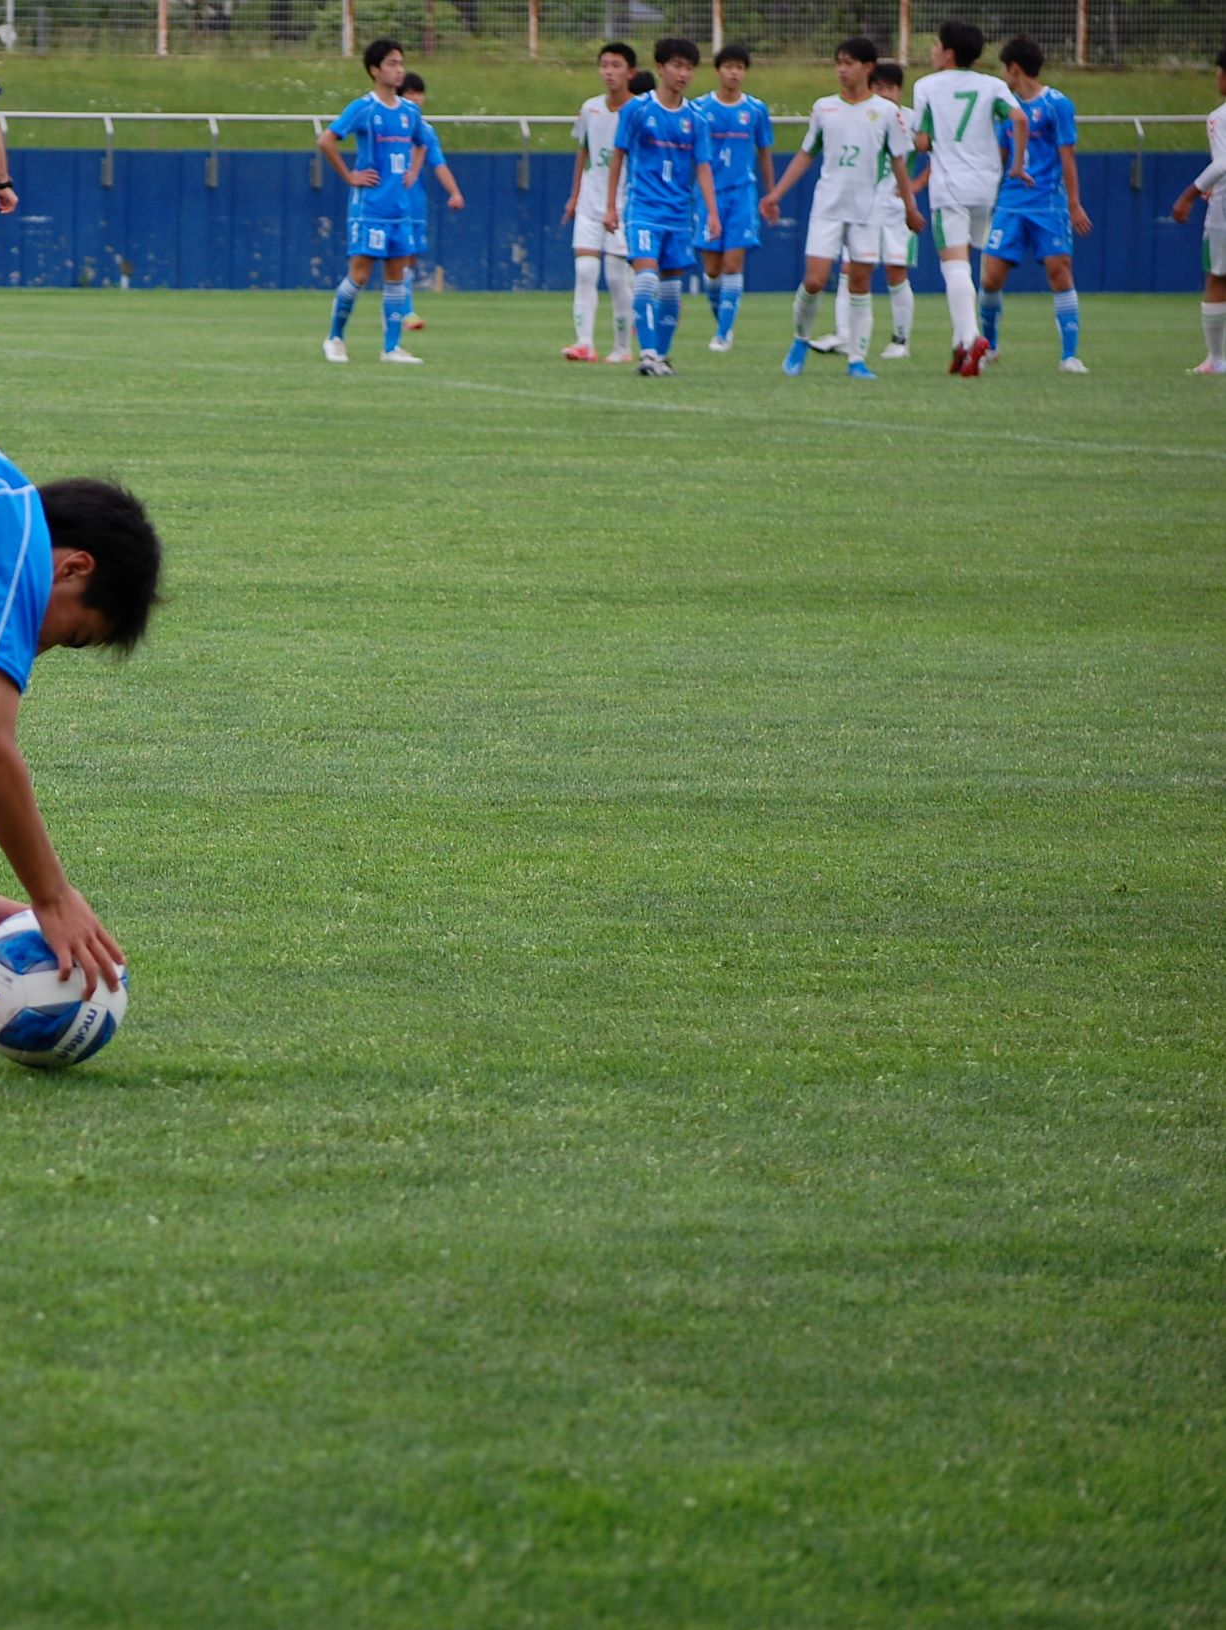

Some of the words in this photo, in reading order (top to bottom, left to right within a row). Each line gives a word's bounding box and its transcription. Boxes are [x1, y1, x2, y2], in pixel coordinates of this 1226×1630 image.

[954, 90, 978, 142] 7
[838, 145, 860, 167] 22
[56, 1008, 97, 1059] molten
